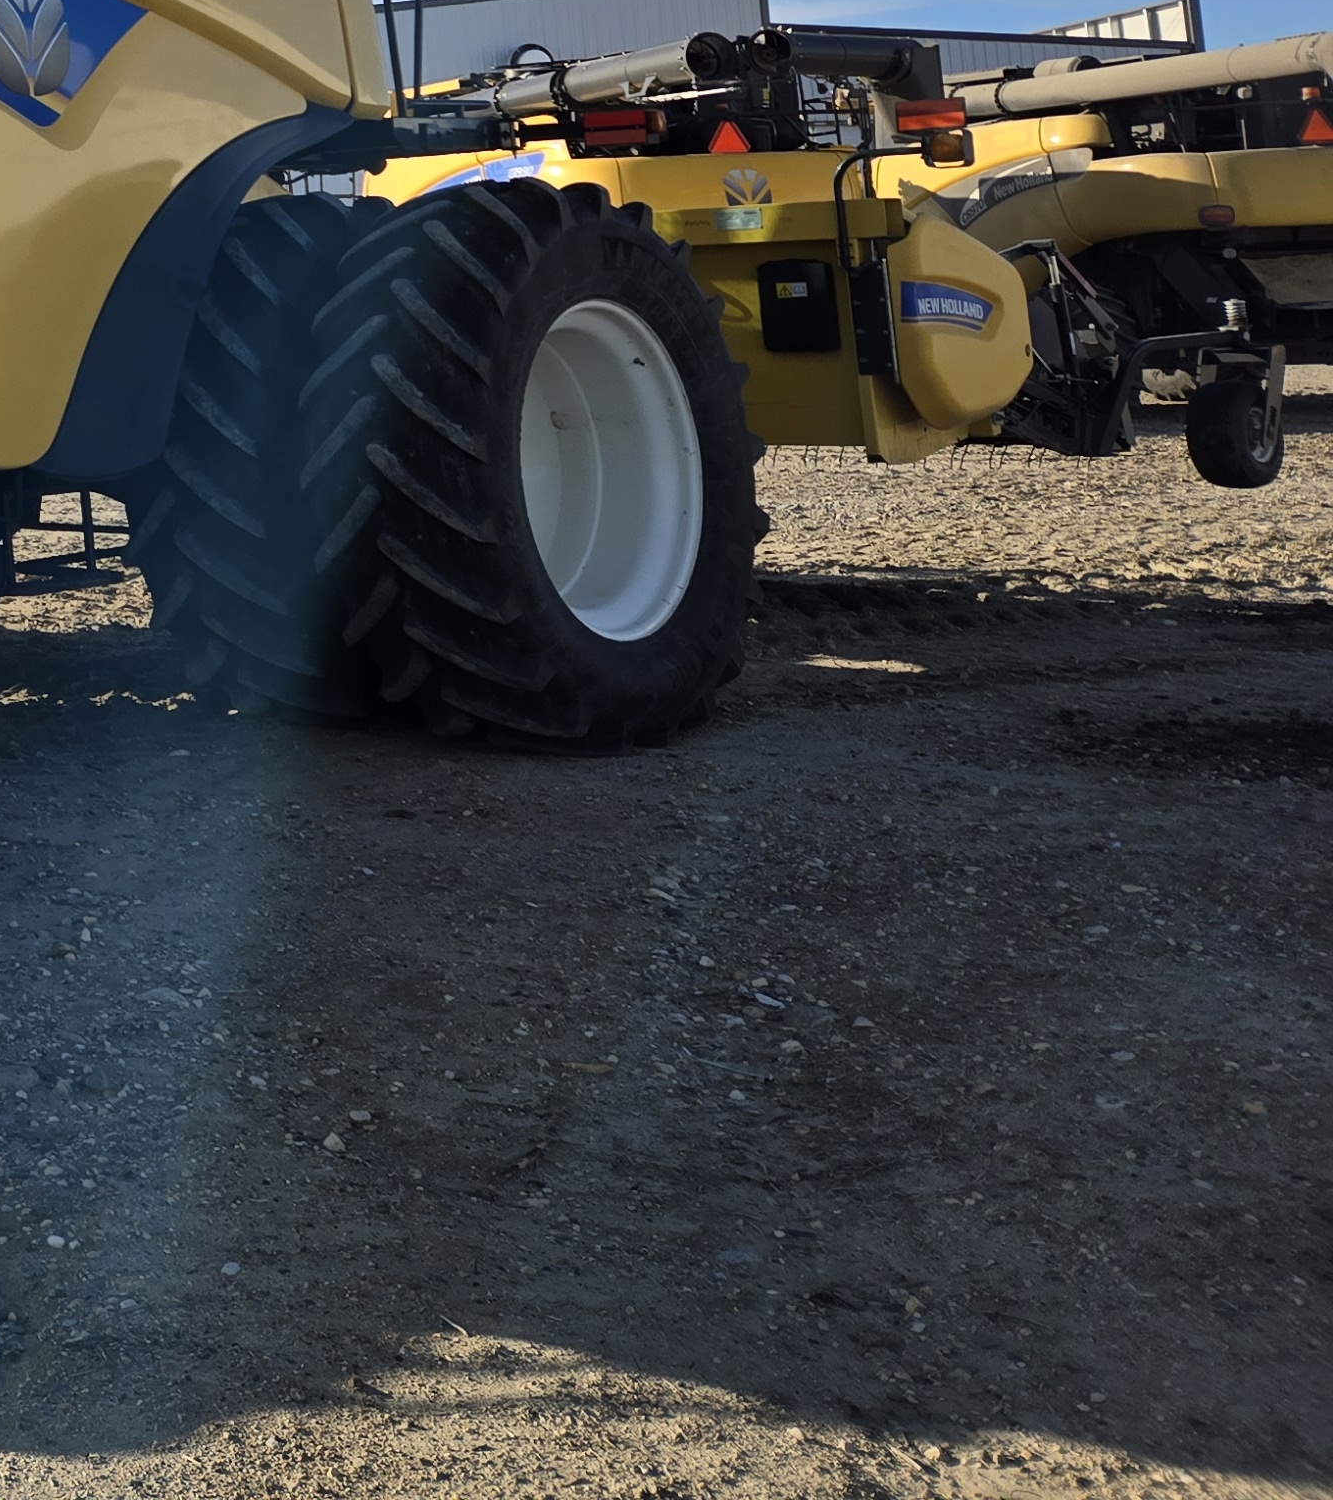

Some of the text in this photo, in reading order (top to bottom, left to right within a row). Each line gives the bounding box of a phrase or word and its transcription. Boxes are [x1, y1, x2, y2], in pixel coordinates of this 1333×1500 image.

[993, 181, 1016, 201] New
[917, 297, 984, 320] NEW HOLLAND
